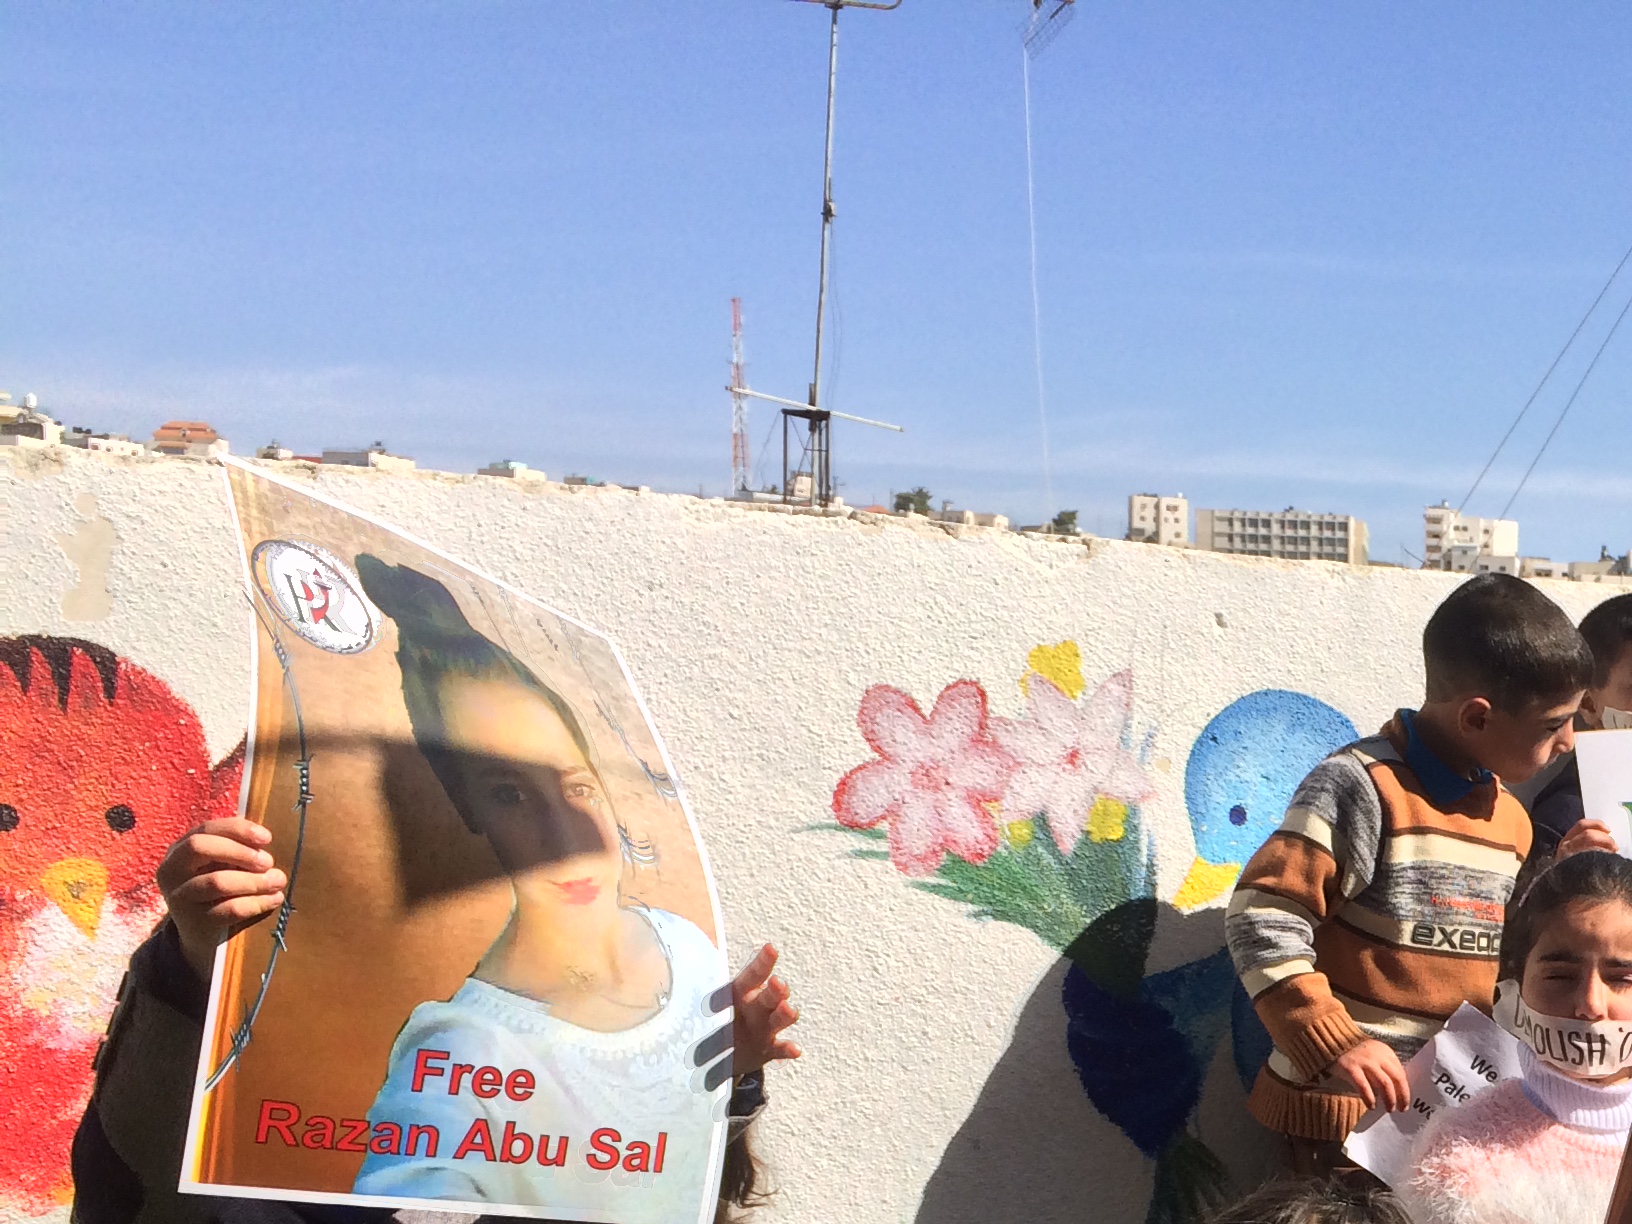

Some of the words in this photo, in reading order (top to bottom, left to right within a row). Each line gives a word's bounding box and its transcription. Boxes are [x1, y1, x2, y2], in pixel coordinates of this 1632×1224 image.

[411, 1048, 536, 1102] Free
[1470, 1055, 1498, 1082] We
[255, 1099, 440, 1158] Razan
[454, 1118, 569, 1167] Abu
[586, 1127, 668, 1174] Sal
